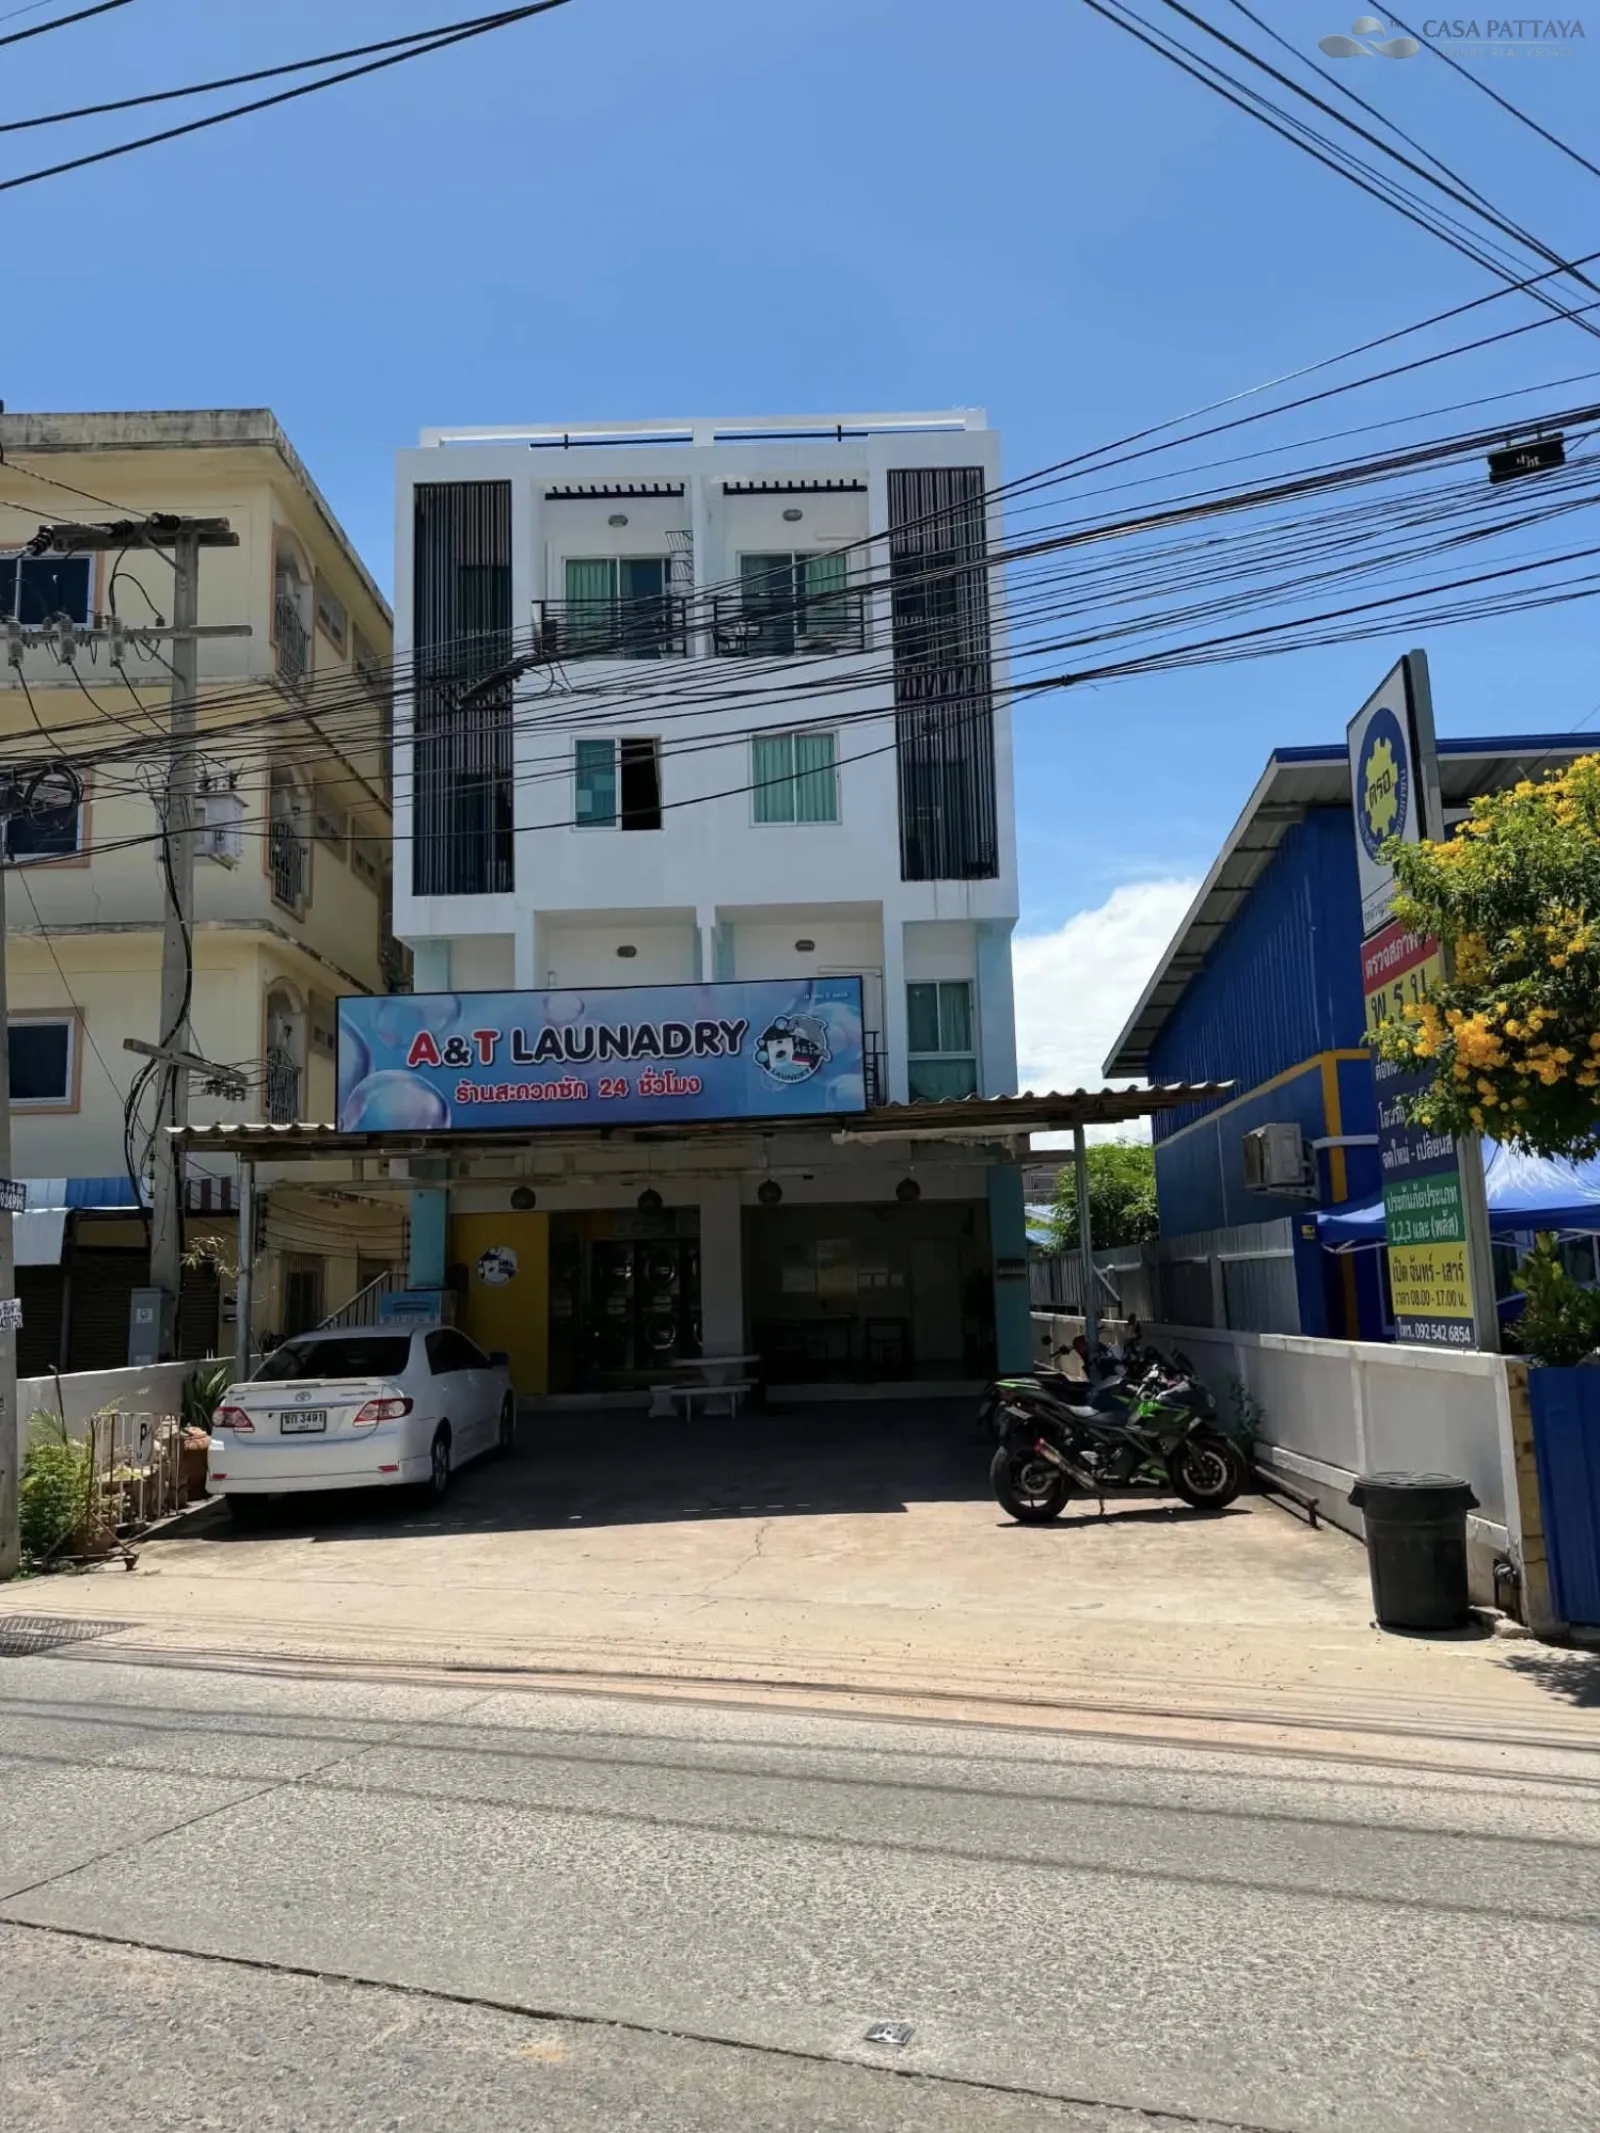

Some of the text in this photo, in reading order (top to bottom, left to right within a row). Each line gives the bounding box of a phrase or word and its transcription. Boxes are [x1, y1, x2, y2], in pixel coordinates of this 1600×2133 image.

[407, 1020, 748, 1068] A&T LAUNADRY
[598, 1077, 629, 1098] 24
[638, 1065, 702, 1096] ชั่วโมง
